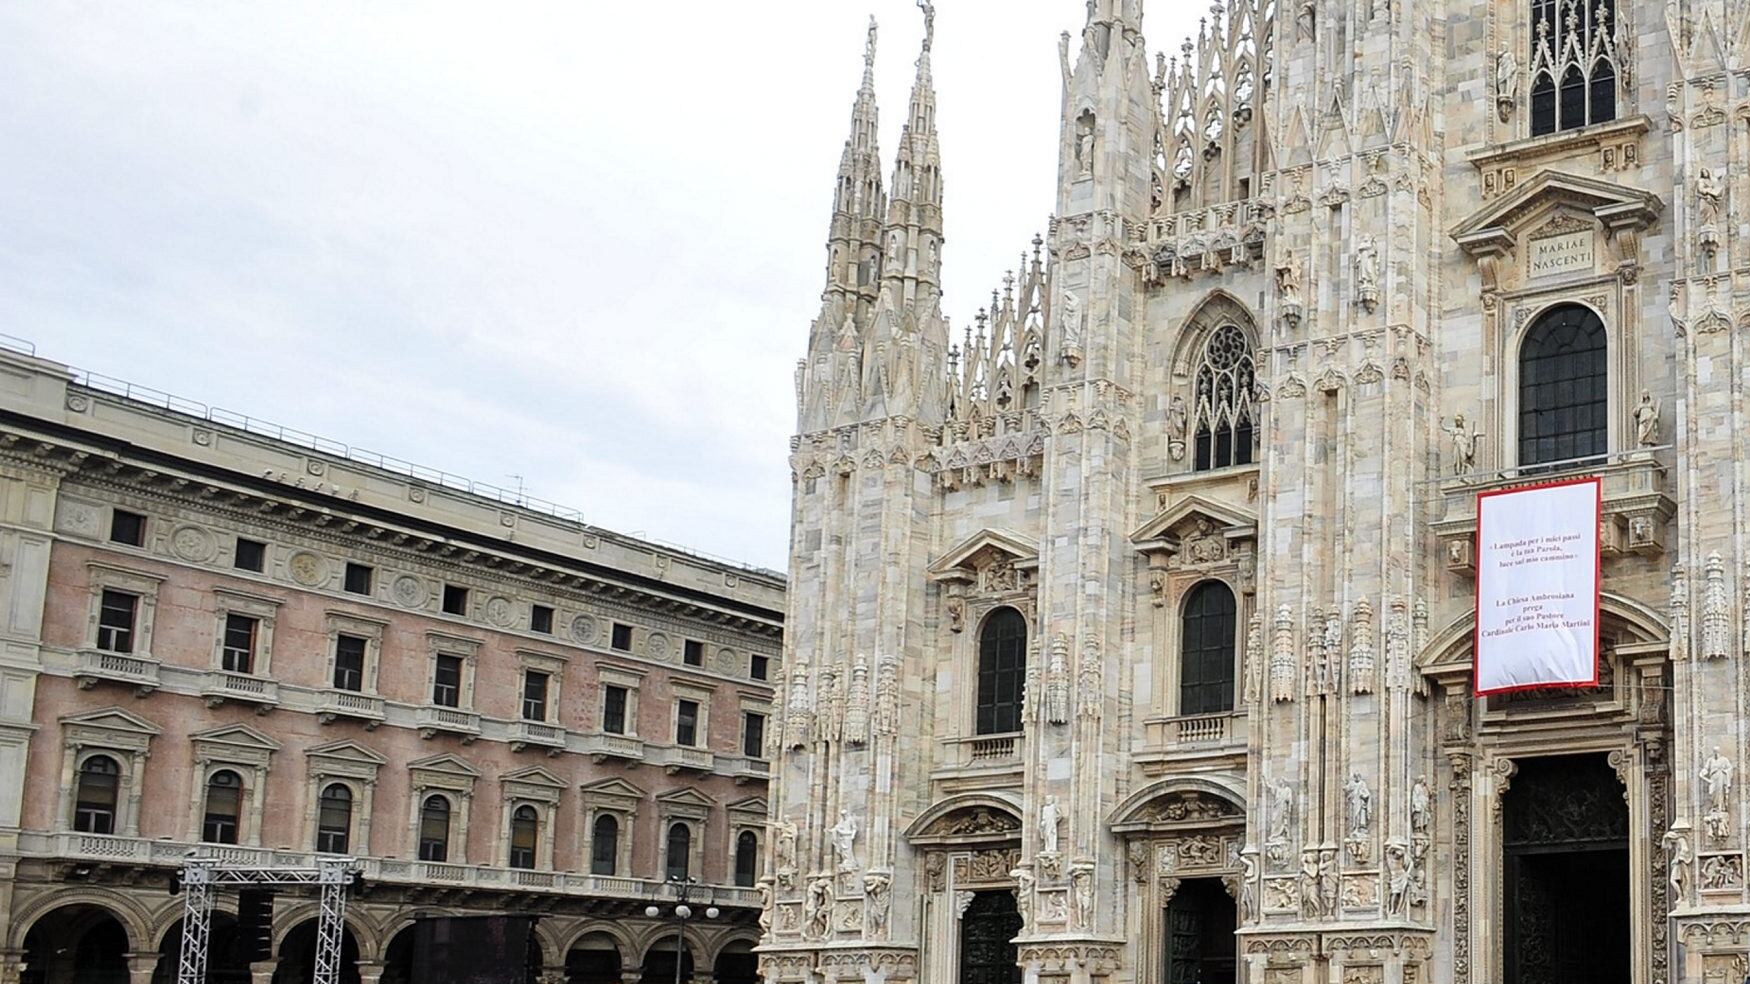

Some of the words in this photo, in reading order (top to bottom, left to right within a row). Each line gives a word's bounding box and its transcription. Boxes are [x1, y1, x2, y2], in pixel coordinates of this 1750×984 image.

[1539, 238, 1585, 255] MARIAE
[1533, 252, 1591, 271] NASCENTI
[1561, 619, 1591, 628] Martini
